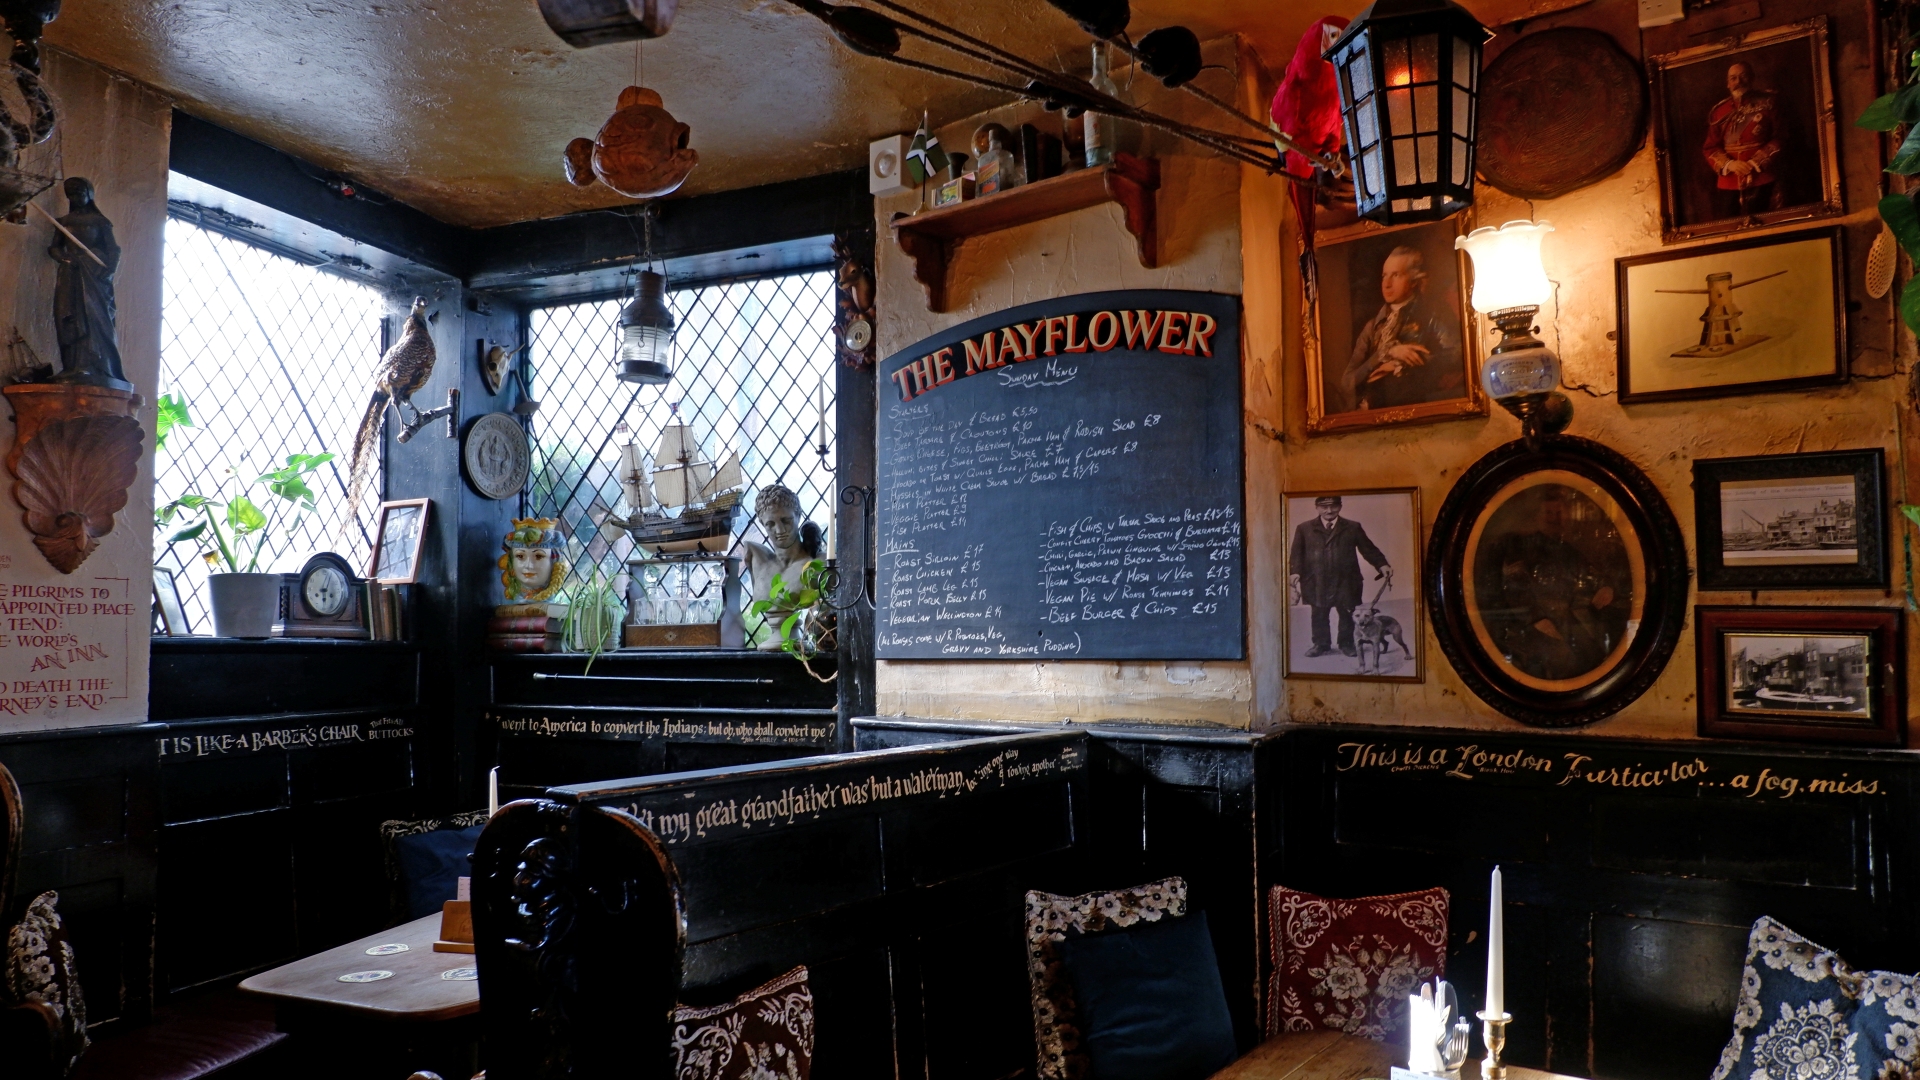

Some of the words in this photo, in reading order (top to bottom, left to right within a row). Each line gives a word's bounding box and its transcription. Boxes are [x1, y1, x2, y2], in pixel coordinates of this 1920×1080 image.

[892, 347, 955, 402] THE
[962, 309, 1217, 375] MAYFLOWER
[12, 585, 84, 602] PILGRIMS
[91, 587, 110, 599] TO
[92, 603, 136, 615] PLACE
[8, 617, 63, 634] TEND:
[17, 633, 78, 651] WORLD'S
[30, 652, 67, 672] AN
[67, 642, 109, 663] INN
[12, 679, 72, 694] DEATH
[77, 678, 113, 691] THE
[65, 694, 108, 710] END.
[368, 728, 414, 740] BUTTOCKS
[502, 718, 526, 735] went
[529, 718, 539, 731] to
[537, 716, 587, 737] America
[591, 720, 601, 733] to
[604, 722, 644, 739] convert
[645, 720, 660, 739] the
[708, 721, 723, 736] but
[754, 722, 774, 741] shall
[775, 723, 809, 740] convert
[173, 737, 192, 754] IS
[195, 735, 236, 757] LIKE
[236, 734, 249, 749] A
[251, 725, 317, 752] BARBER'S
[320, 724, 365, 742] CHAIR
[1336, 742, 1397, 772] This
[1404, 742, 1423, 765] is
[1428, 747, 1448, 766] a
[1445, 744, 1553, 781] London
[1808, 773, 1887, 795] miss.
[659, 812, 691, 844] my
[696, 800, 738, 838] great
[742, 783, 841, 829] grandfather
[841, 777, 870, 805] was
[870, 775, 893, 801] but
[893, 780, 902, 797] a
